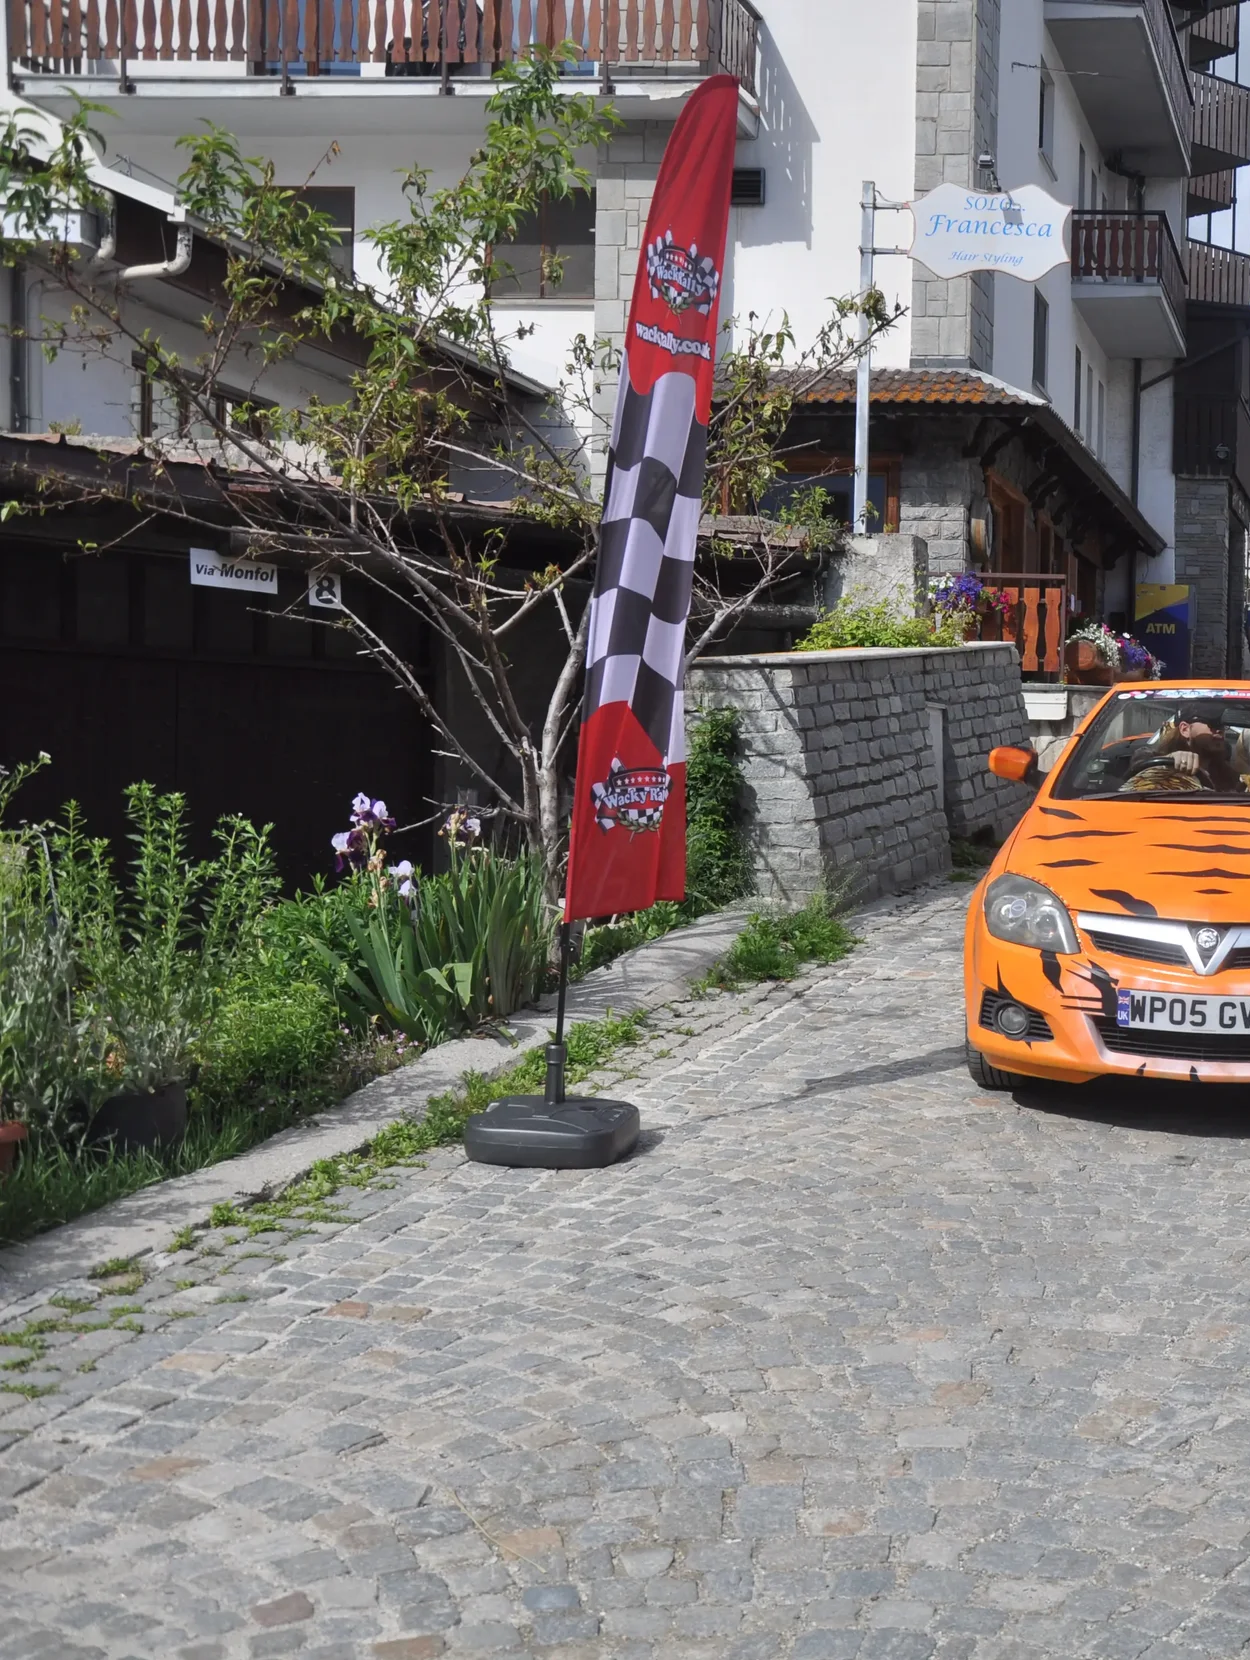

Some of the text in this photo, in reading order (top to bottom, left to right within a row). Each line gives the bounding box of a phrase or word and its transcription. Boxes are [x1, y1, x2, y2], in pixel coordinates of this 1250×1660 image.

[925, 214, 1053, 238] Francesca
[948, 251, 1025, 267] Hair Styling
[195, 563, 275, 583] Via Monfol
[315, 575, 337, 604] 8
[1146, 623, 1175, 634] ATM
[603, 789, 647, 809] Wacky
[1117, 1010, 1129, 1021] UK
[1130, 994, 1208, 1027] WP05
